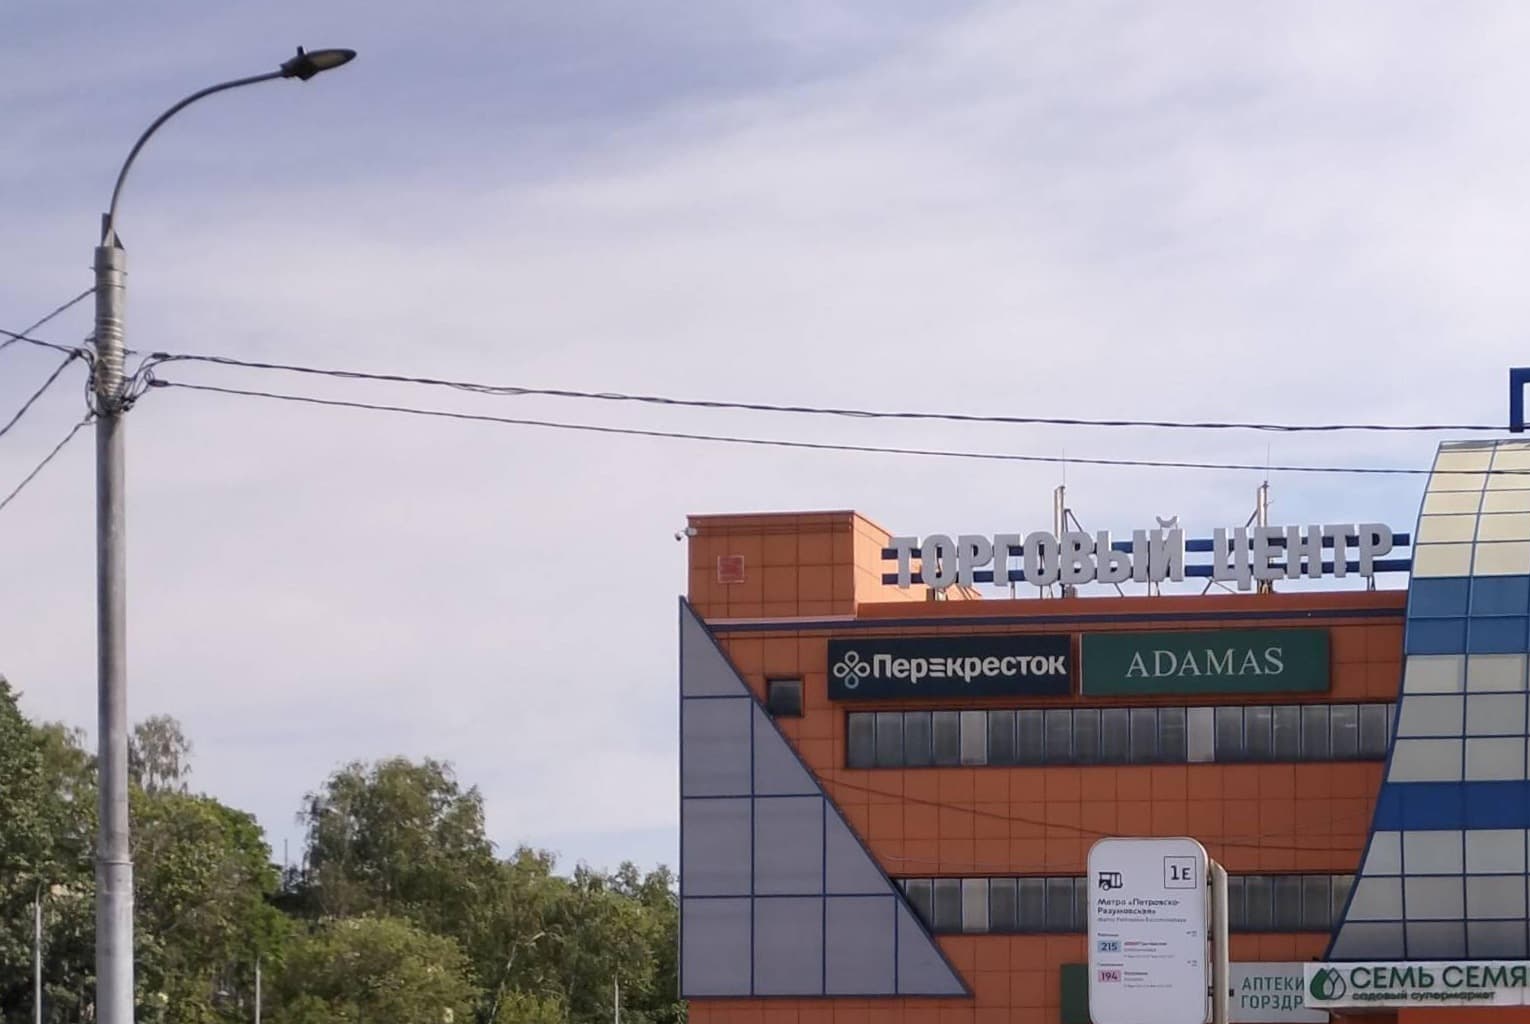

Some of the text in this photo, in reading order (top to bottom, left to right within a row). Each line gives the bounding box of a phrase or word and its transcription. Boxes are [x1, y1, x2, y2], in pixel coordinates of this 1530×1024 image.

[889, 514, 1394, 590] ТОРГОВЫЙ ЦЕНТР
[873, 653, 1067, 684] Перекресток
[1124, 646, 1285, 678] ADAMAS
[1241, 976, 1304, 991] АПТЕКИ
[1350, 966, 1435, 989] СЕМЬ
[1241, 994, 1304, 1011] ГОРЗДР
[1351, 990, 1497, 1002] садовый супермаркет
